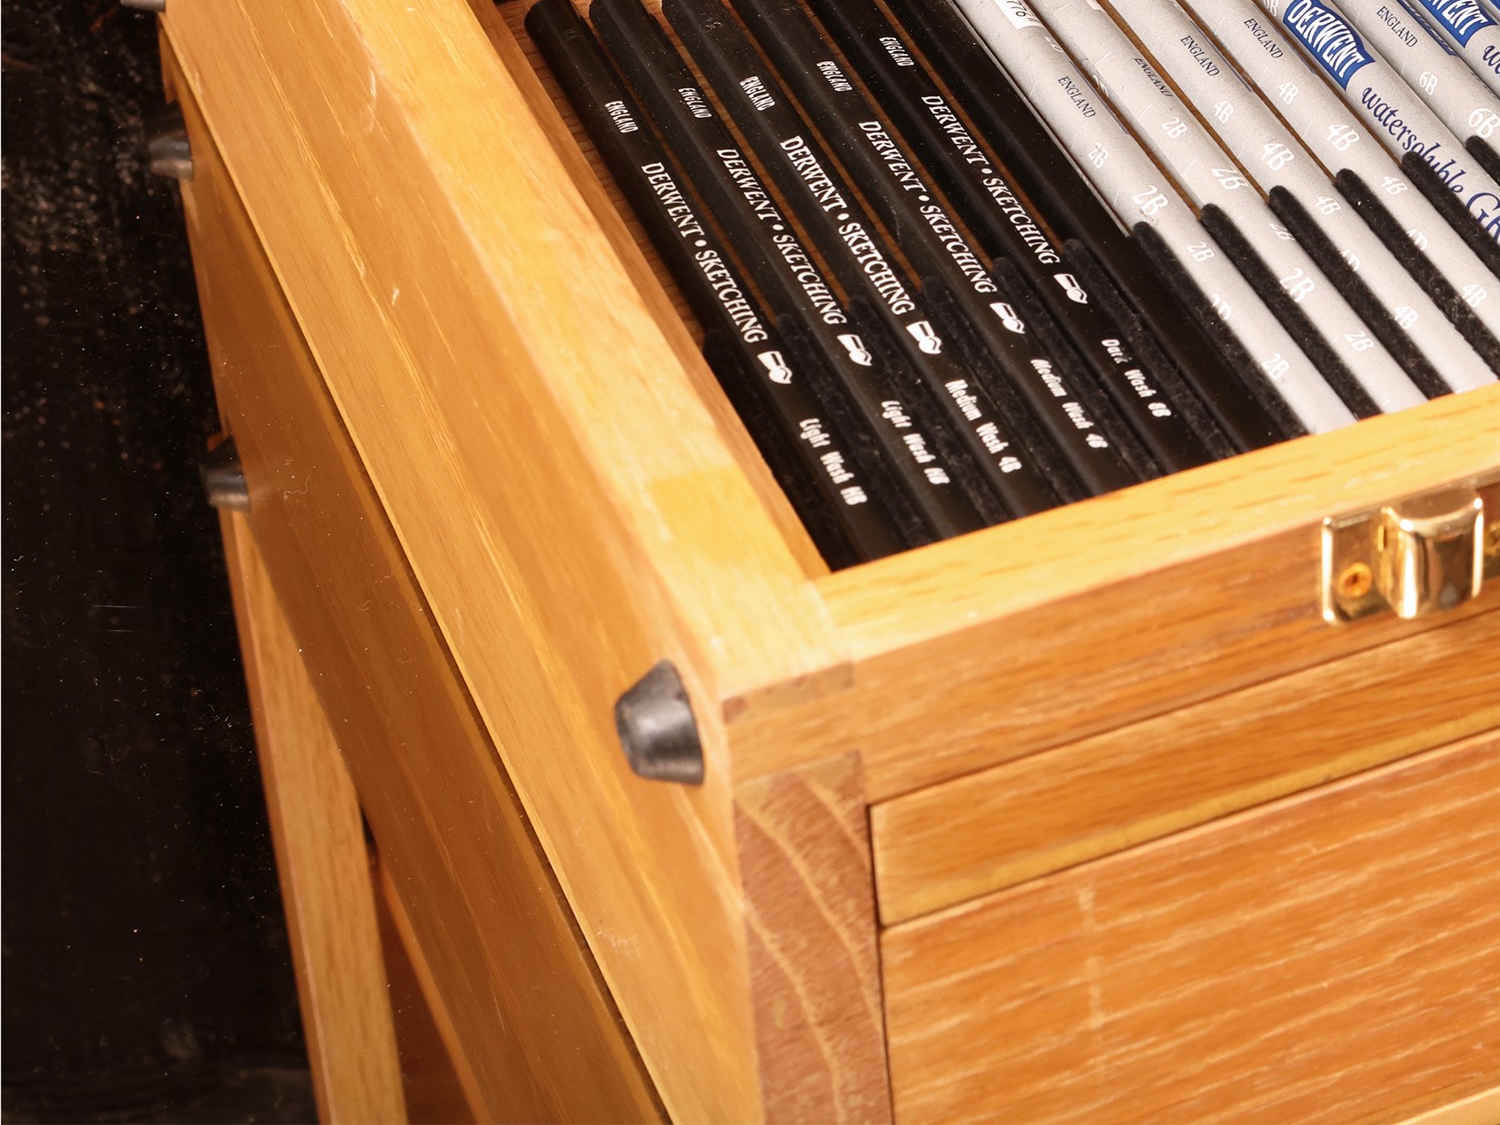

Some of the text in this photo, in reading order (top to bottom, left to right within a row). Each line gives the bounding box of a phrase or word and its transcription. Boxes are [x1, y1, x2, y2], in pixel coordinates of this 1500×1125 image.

[1243, 18, 1284, 59] ENGLAND
[1376, 5, 1418, 49] ENGLAND
[879, 36, 914, 67] ENGLAND
[1181, 35, 1220, 77] ENGLAND
[816, 60, 852, 92] ENGLAND
[1278, 79, 1299, 106] 4B
[1418, 72, 1439, 96] 6B
[679, 87, 712, 119] ENGLAND
[740, 76, 775, 111] ENGLAND
[1058, 76, 1096, 119] ENGLAND
[605, 100, 638, 134] ENGLAND
[1161, 116, 1188, 140] 2B
[1214, 100, 1234, 124] 4B
[1327, 123, 1361, 152] 4B
[1261, 141, 1295, 171] 4B
[922, 95, 1060, 265] DERWENT SKETCHING
[1380, 175, 1408, 196] 4B
[859, 120, 997, 294] DERWENT SKETCHING
[1132, 184, 1169, 217] 2B
[1314, 194, 1341, 216] 4B
[717, 148, 847, 325] DERWENT SKETCHING
[780, 136, 915, 315] DERWENT SKETCHING
[641, 162, 767, 344] DERWENT SKETCHING
[1186, 241, 1215, 263] 2B
[1279, 267, 1316, 303] 2B
[1344, 330, 1374, 352] 2B
[1124, 368, 1156, 398] Wash
[1031, 358, 1108, 449] Medium Wash 4B
[881, 400, 950, 485] Light Wash HB
[945, 379, 1022, 474] Medium Wash 4B
[799, 417, 867, 506] Light Wash HB
